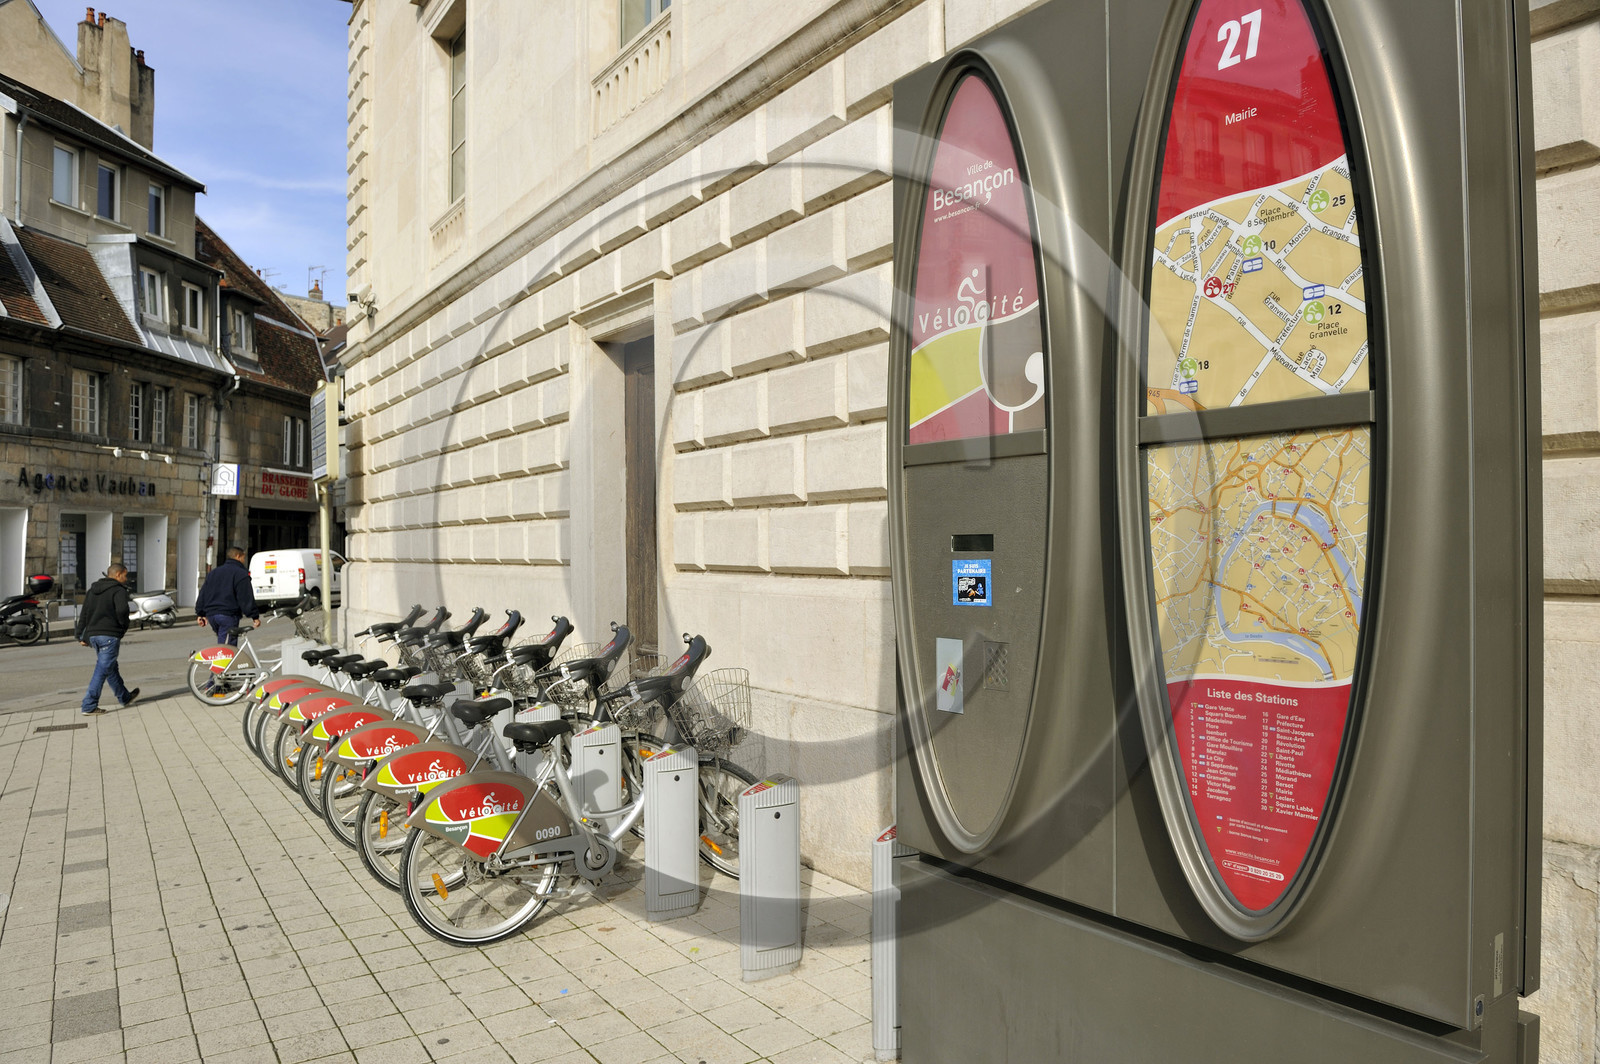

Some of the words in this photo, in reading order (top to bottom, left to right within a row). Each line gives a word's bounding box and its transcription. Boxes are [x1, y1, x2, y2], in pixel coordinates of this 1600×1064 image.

[1217, 9, 1262, 71] 27
[1225, 107, 1257, 125] Mairie
[966, 164, 983, 176] Ville
[983, 160, 993, 170] de
[933, 167, 1014, 211] Besançon
[1255, 194, 1266, 207] rue
[1332, 195, 1346, 207] 25
[1260, 207, 1281, 217] Place
[1346, 210, 1357, 225] rue
[1209, 212, 1230, 227] Grande
[1247, 220, 1253, 228] 8
[1253, 210, 1295, 226] Septembre
[1287, 201, 1300, 212] des
[1321, 225, 1350, 242] Granges
[1199, 225, 1222, 253] d'Anvers
[1200, 229, 1211, 241] rue
[1289, 222, 1312, 248] Moncey
[1263, 240, 1276, 251] 10
[1191, 245, 1199, 272] Pasteur
[1276, 258, 1287, 271] Rue
[1158, 255, 1167, 264] rue
[1169, 264, 1177, 273] du
[1180, 271, 1197, 283] Lycée
[1226, 259, 1241, 281] Palais
[1223, 283, 1235, 295] 27
[1269, 291, 1281, 303] rue
[1187, 295, 1200, 327] Chamars
[1264, 297, 1291, 323] Granvelle
[1328, 304, 1342, 315] 12
[1276, 309, 1302, 345] Préfecture
[1317, 321, 1340, 331] Place
[1309, 327, 1348, 339] Granvelle
[1237, 316, 1247, 326] rue
[1269, 347, 1298, 373] Mégevand
[1198, 361, 1210, 370] 18
[1252, 371, 1259, 379] la
[1335, 379, 1345, 389] rue
[1148, 389, 1160, 398] 945
[1239, 388, 1247, 397] de
[18, 467, 89, 494] Agence
[96, 474, 156, 497] Vauban
[262, 472, 308, 488] BRASSERIE
[262, 484, 275, 495] DU
[280, 487, 308, 499] GLOBE
[1207, 687, 1232, 700] Liste
[1234, 690, 1253, 701] des
[1255, 692, 1299, 707] Stations
[1276, 713, 1289, 721] Gare
[1206, 722, 1219, 730] Flore
[1276, 720, 1304, 729] Préfecture
[1276, 727, 1314, 737] Saint-Jacques
[1276, 733, 1306, 743] Beaux-Arts
[1230, 738, 1253, 747] Tourisme
[1276, 747, 1304, 756] Saint-Paul
[1276, 753, 1295, 762] Liberté
[1213, 755, 1224, 763] City
[1276, 761, 1296, 769] Rivotte
[1210, 761, 1239, 771] Septembre
[1276, 774, 1298, 783] Morand
[1222, 782, 1236, 790] Hugo
[1276, 781, 1294, 789] Bersot
[1276, 787, 1293, 796] Mairie
[1276, 794, 1295, 803] Leclerc
[1276, 801, 1295, 810] Square
[1276, 807, 1293, 816] Xavier
[1294, 811, 1319, 821] Marmier
[445, 825, 469, 833] Besançon
[535, 825, 561, 841] 0090
